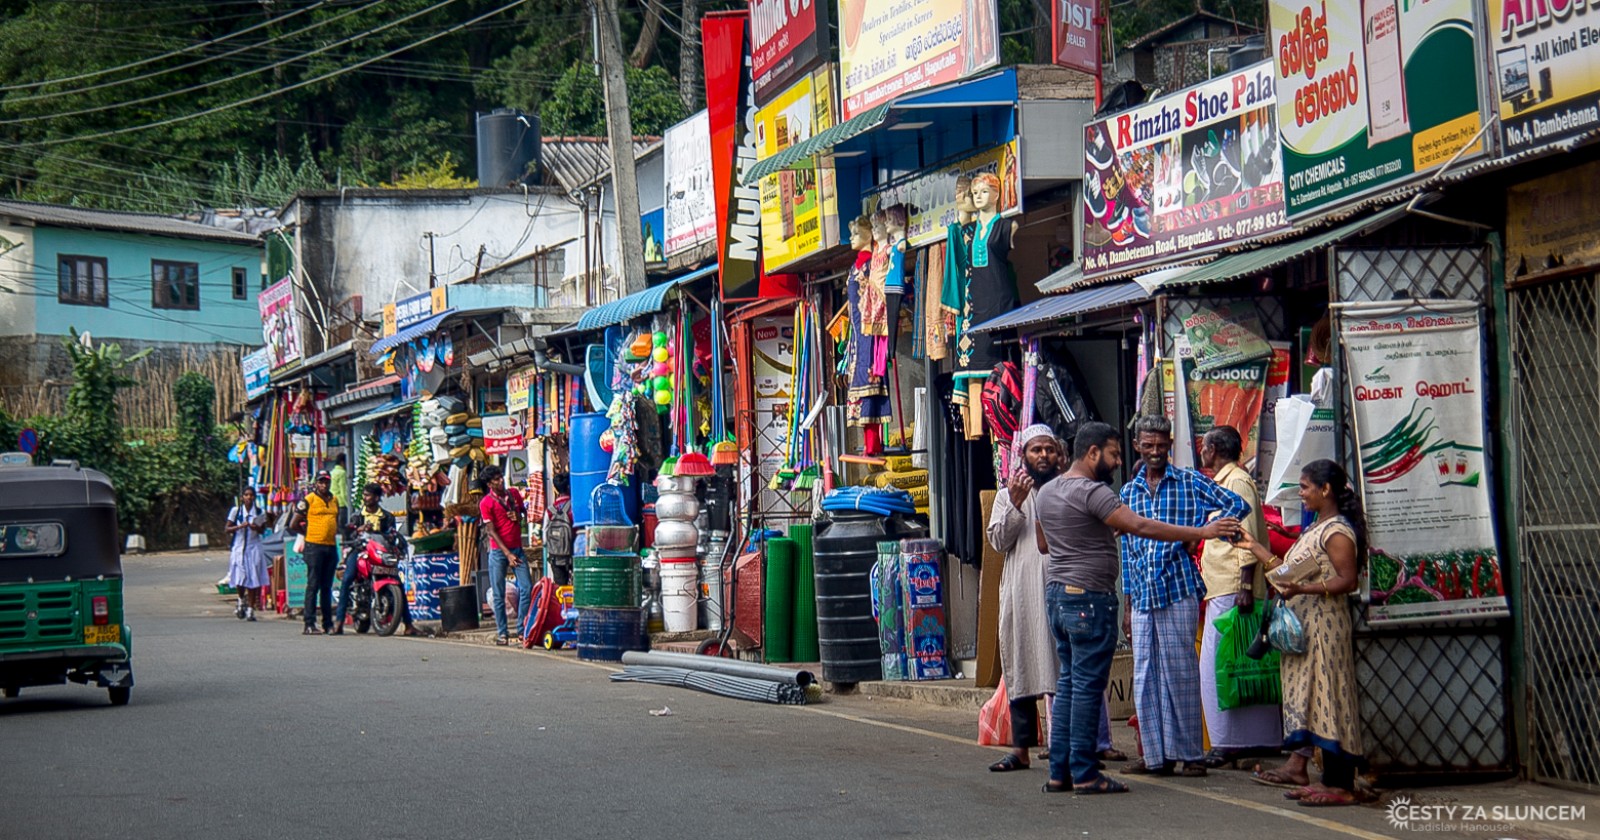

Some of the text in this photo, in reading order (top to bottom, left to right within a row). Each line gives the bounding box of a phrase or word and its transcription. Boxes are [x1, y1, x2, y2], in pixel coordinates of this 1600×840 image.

[1062, 0, 1092, 31] DSI
[1066, 33, 1086, 48] DEALER
[1552, 32, 1578, 58] kind
[1580, 26, 1600, 49] Ele
[1294, 51, 1359, 127] පොහොර
[1116, 105, 1181, 150] Rimzha
[1185, 89, 1229, 128] Shoe
[1533, 105, 1598, 139] Dambetenna
[1289, 155, 1346, 192] CITY CHEMICALS
[1085, 256, 1097, 270] No.
[1109, 243, 1154, 264] Dambetenna
[1155, 237, 1177, 254] Road,
[1177, 227, 1215, 249] Haputale.
[757, 330, 777, 340] New
[1354, 377, 1475, 402] மெகா ஹொட்
[487, 426, 516, 436] Dialog
